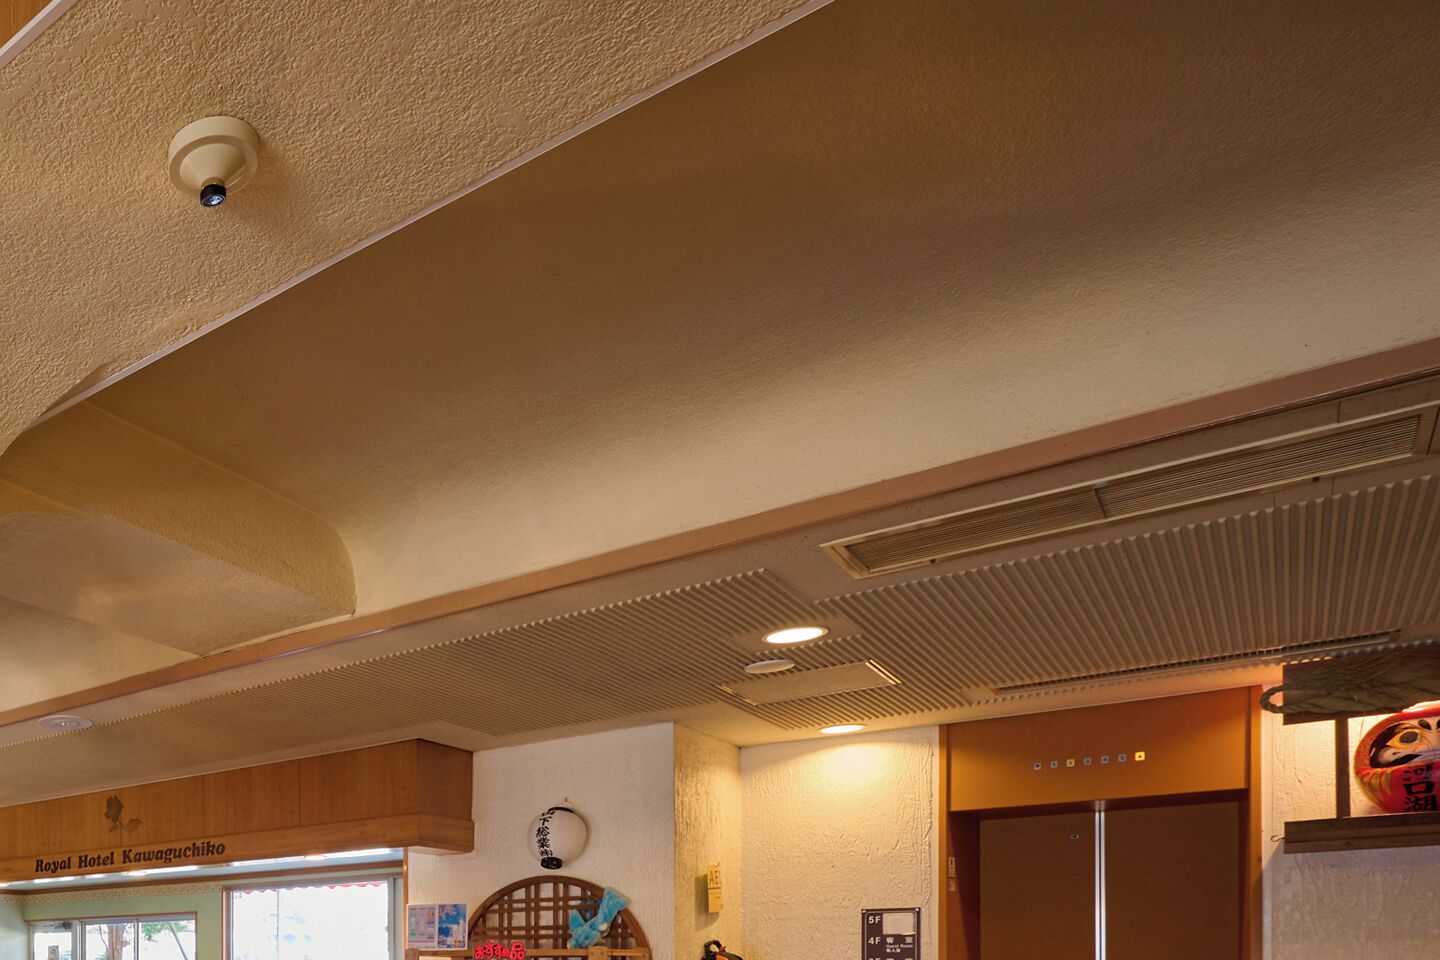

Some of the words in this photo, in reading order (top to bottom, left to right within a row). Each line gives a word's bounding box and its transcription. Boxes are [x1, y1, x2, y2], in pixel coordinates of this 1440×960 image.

[1403, 762, 1437, 812] 河口湖
[35, 857, 72, 873] Royal
[78, 852, 115, 869] Hotel
[122, 841, 226, 863] Kawaguchiko
[709, 870, 721, 885] AE
[868, 916, 881, 924] 5F
[868, 937, 881, 945] 4F
[474, 940, 527, 960] おすすめ品
